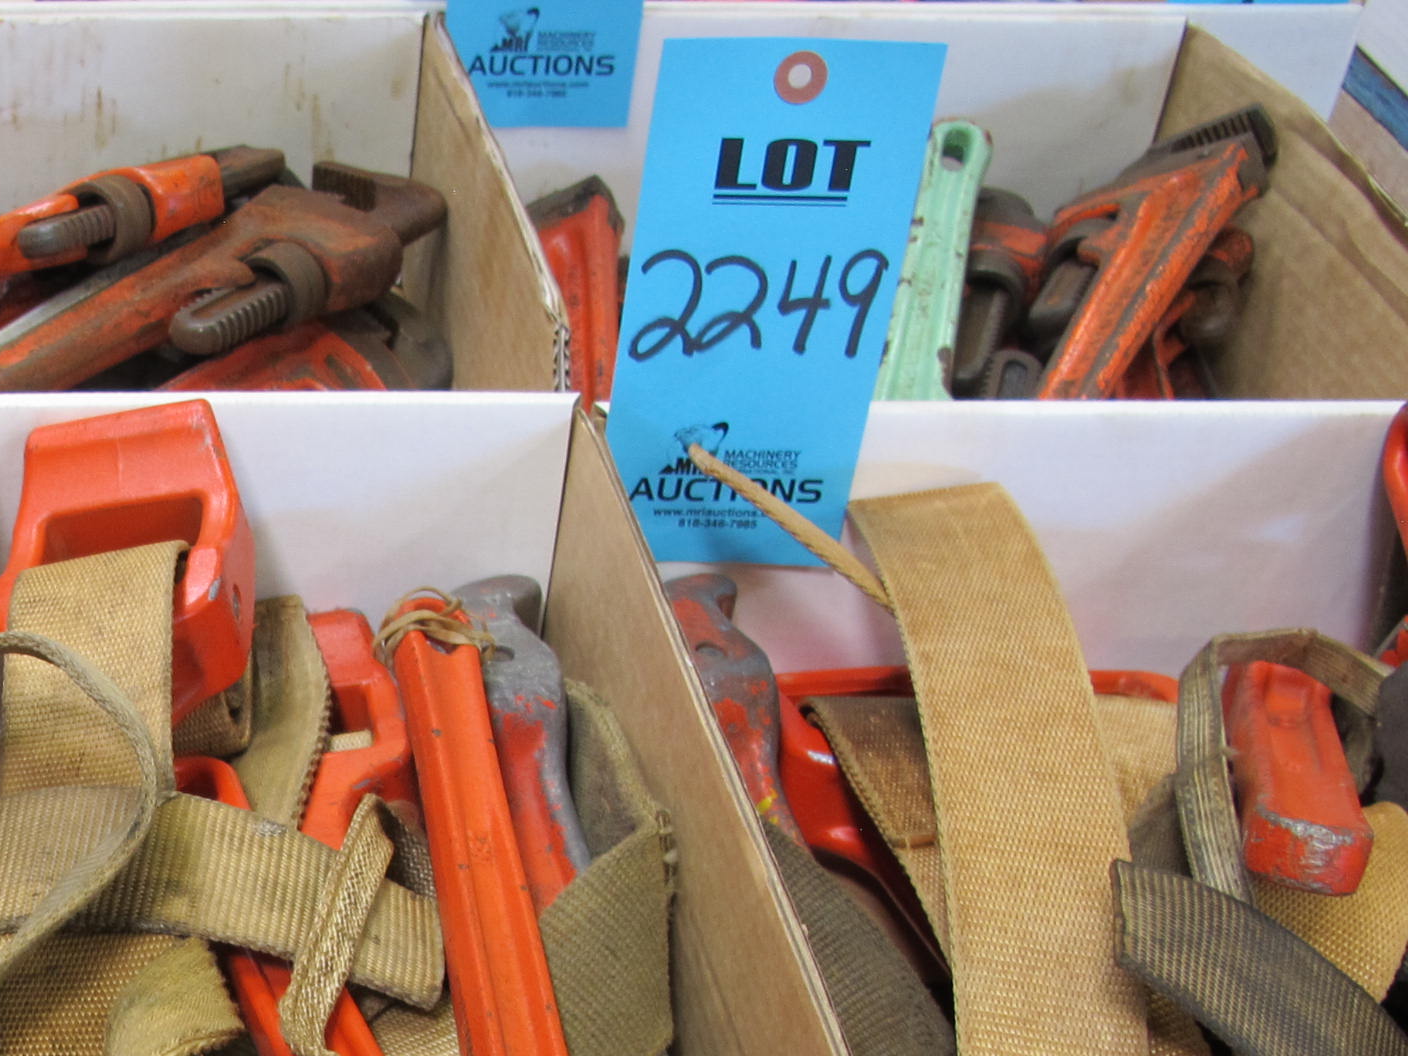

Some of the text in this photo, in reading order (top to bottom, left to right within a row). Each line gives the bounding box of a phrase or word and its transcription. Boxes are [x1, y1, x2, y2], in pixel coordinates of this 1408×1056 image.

[468, 54, 615, 76] AUCTIONS
[713, 137, 871, 192] LOT
[628, 249, 889, 361] 2249
[724, 450, 801, 461] MACHINERY
[630, 477, 823, 503] AUCTINS
[654, 507, 764, 518] www.mriauctions.
